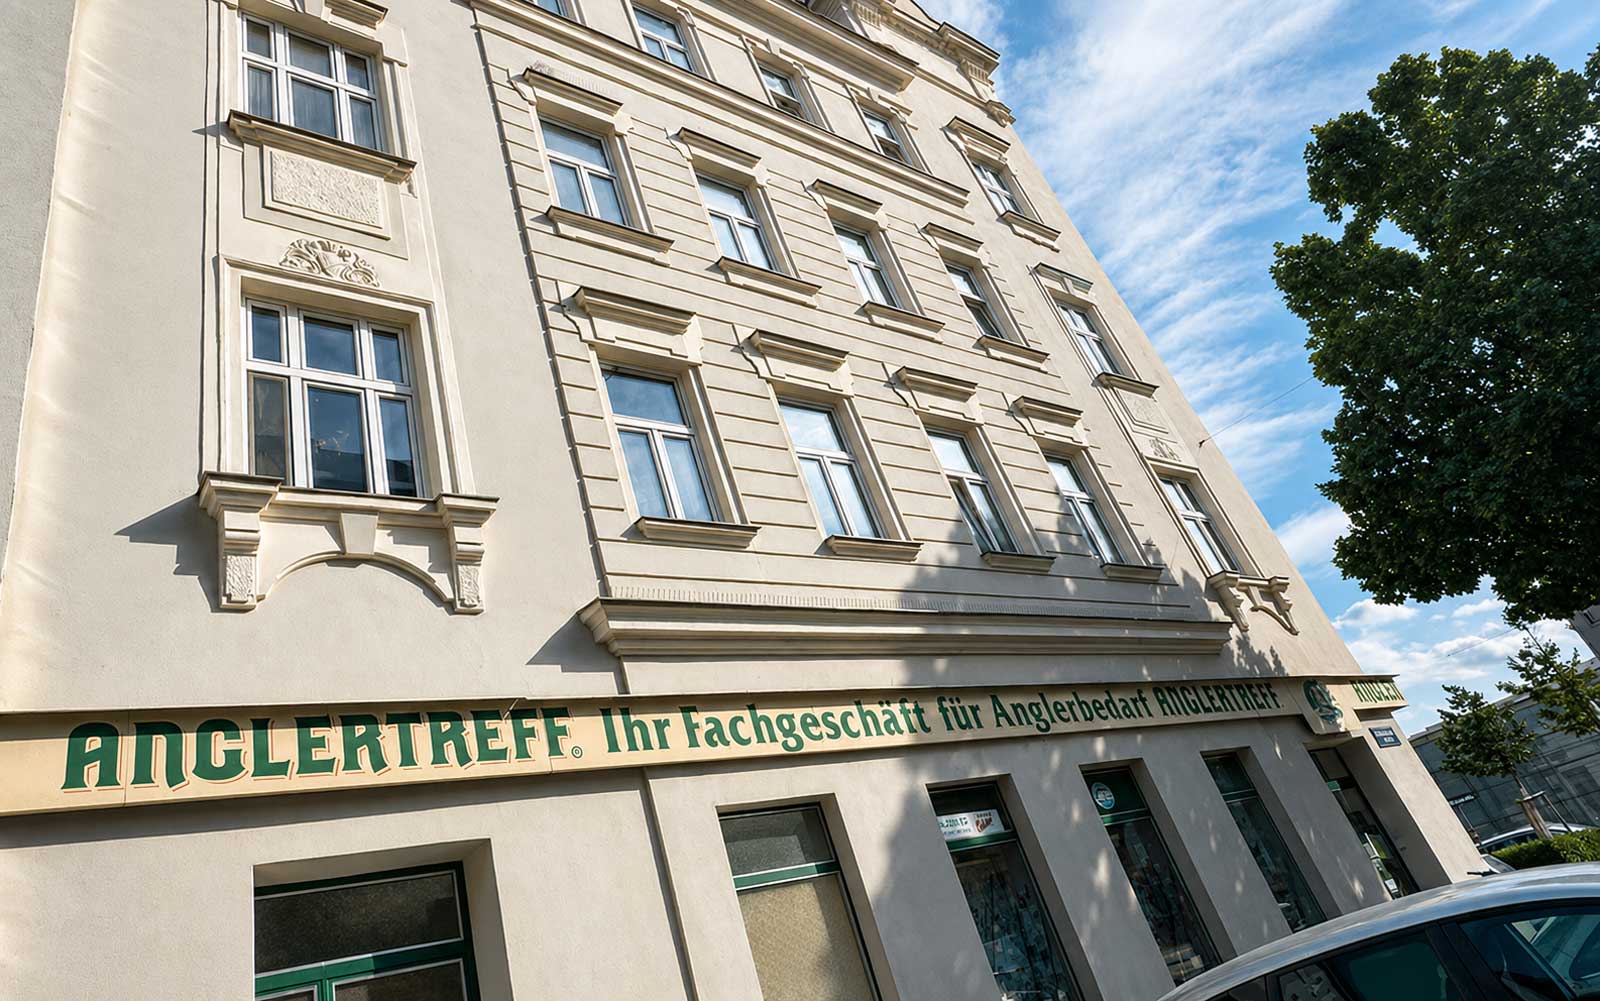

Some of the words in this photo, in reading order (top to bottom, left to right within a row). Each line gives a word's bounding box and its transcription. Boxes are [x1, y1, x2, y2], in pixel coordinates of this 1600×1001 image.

[601, 707, 670, 753] Ihr
[678, 697, 931, 752] Fachgeschäft
[937, 694, 983, 732] für
[990, 688, 1153, 733] Anglerbedarf
[1157, 683, 1281, 717] ANGLERTREFF
